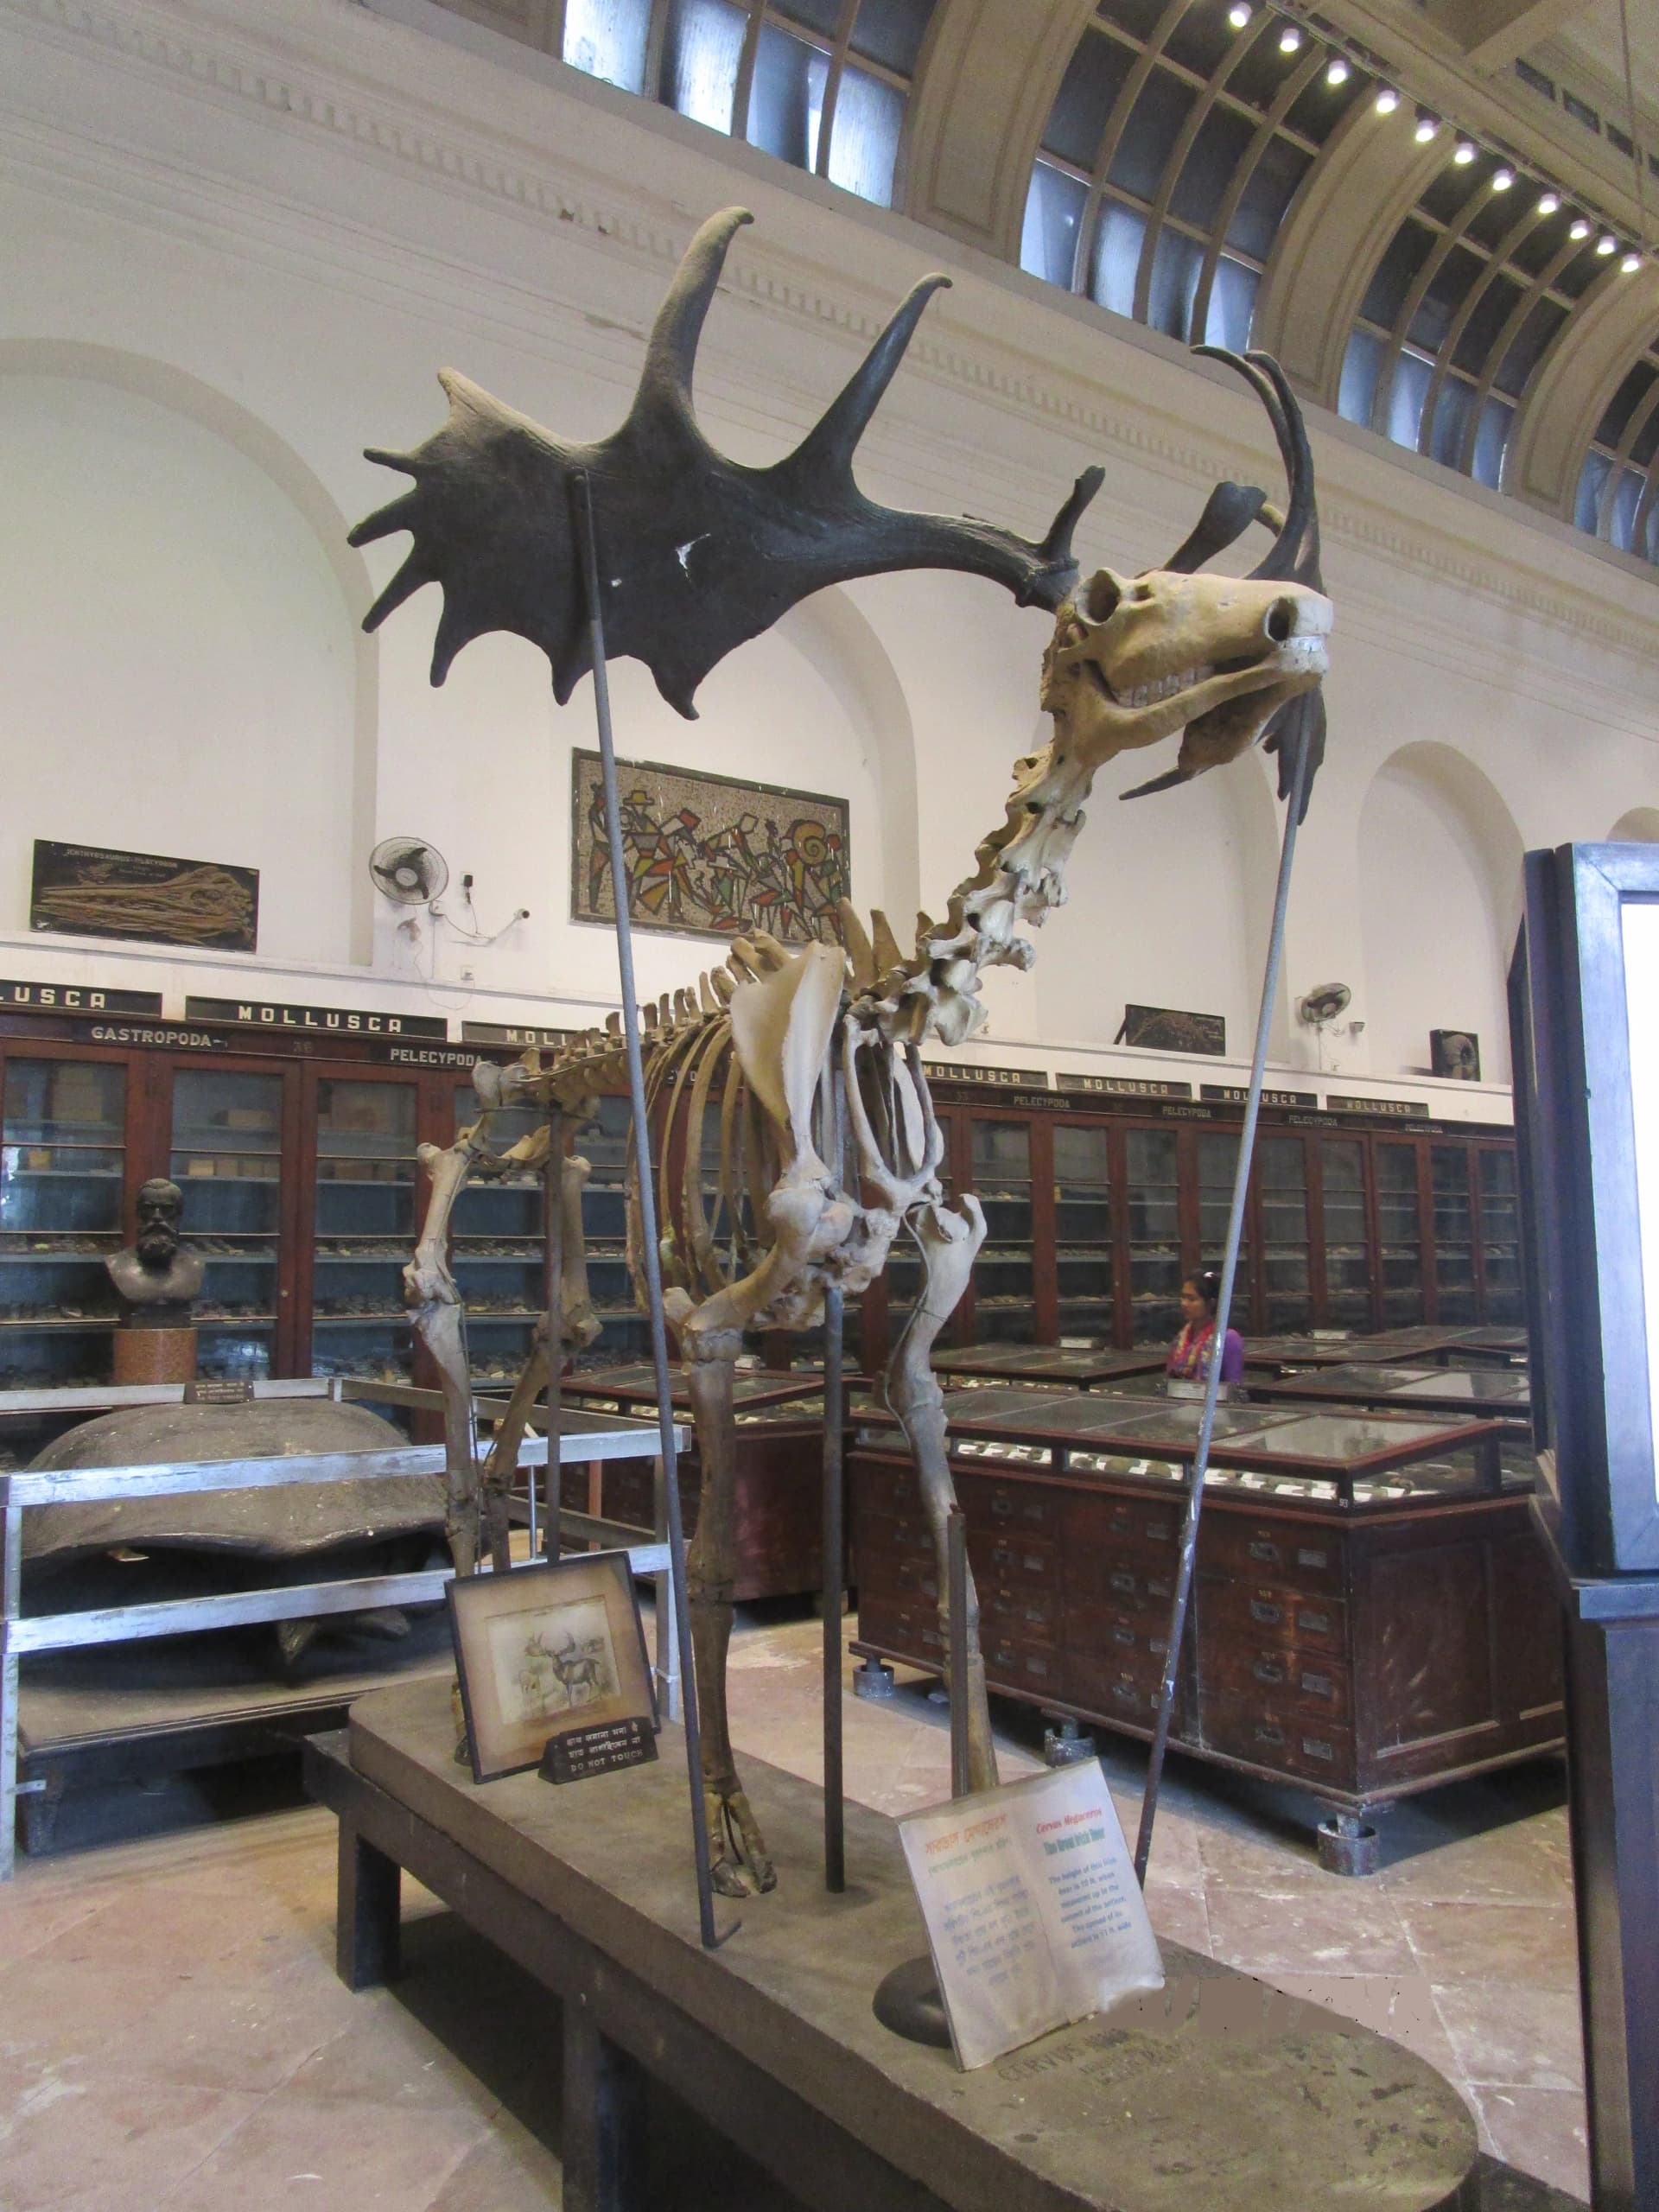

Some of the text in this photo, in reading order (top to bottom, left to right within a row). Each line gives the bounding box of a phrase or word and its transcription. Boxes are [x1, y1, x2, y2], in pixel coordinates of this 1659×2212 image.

[0, 986, 105, 1009] USCA
[238, 1005, 402, 1033] MOLLUSCA
[92, 1026, 213, 1047] GASTROPODA
[505, 1029, 568, 1046] MOLL
[390, 1048, 482, 1067] PELECYPODA
[923, 1065, 1021, 1084] MOLLUSCA
[1083, 1078, 1169, 1096] MOLLUSCA
[1224, 1089, 1297, 1104] MOLUSCA
[1014, 1096, 1071, 1109] PELECYPODA
[1346, 1100, 1412, 1114] MOLLUSCA
[570, 1749, 644, 1772] DO NOT TOUCH
